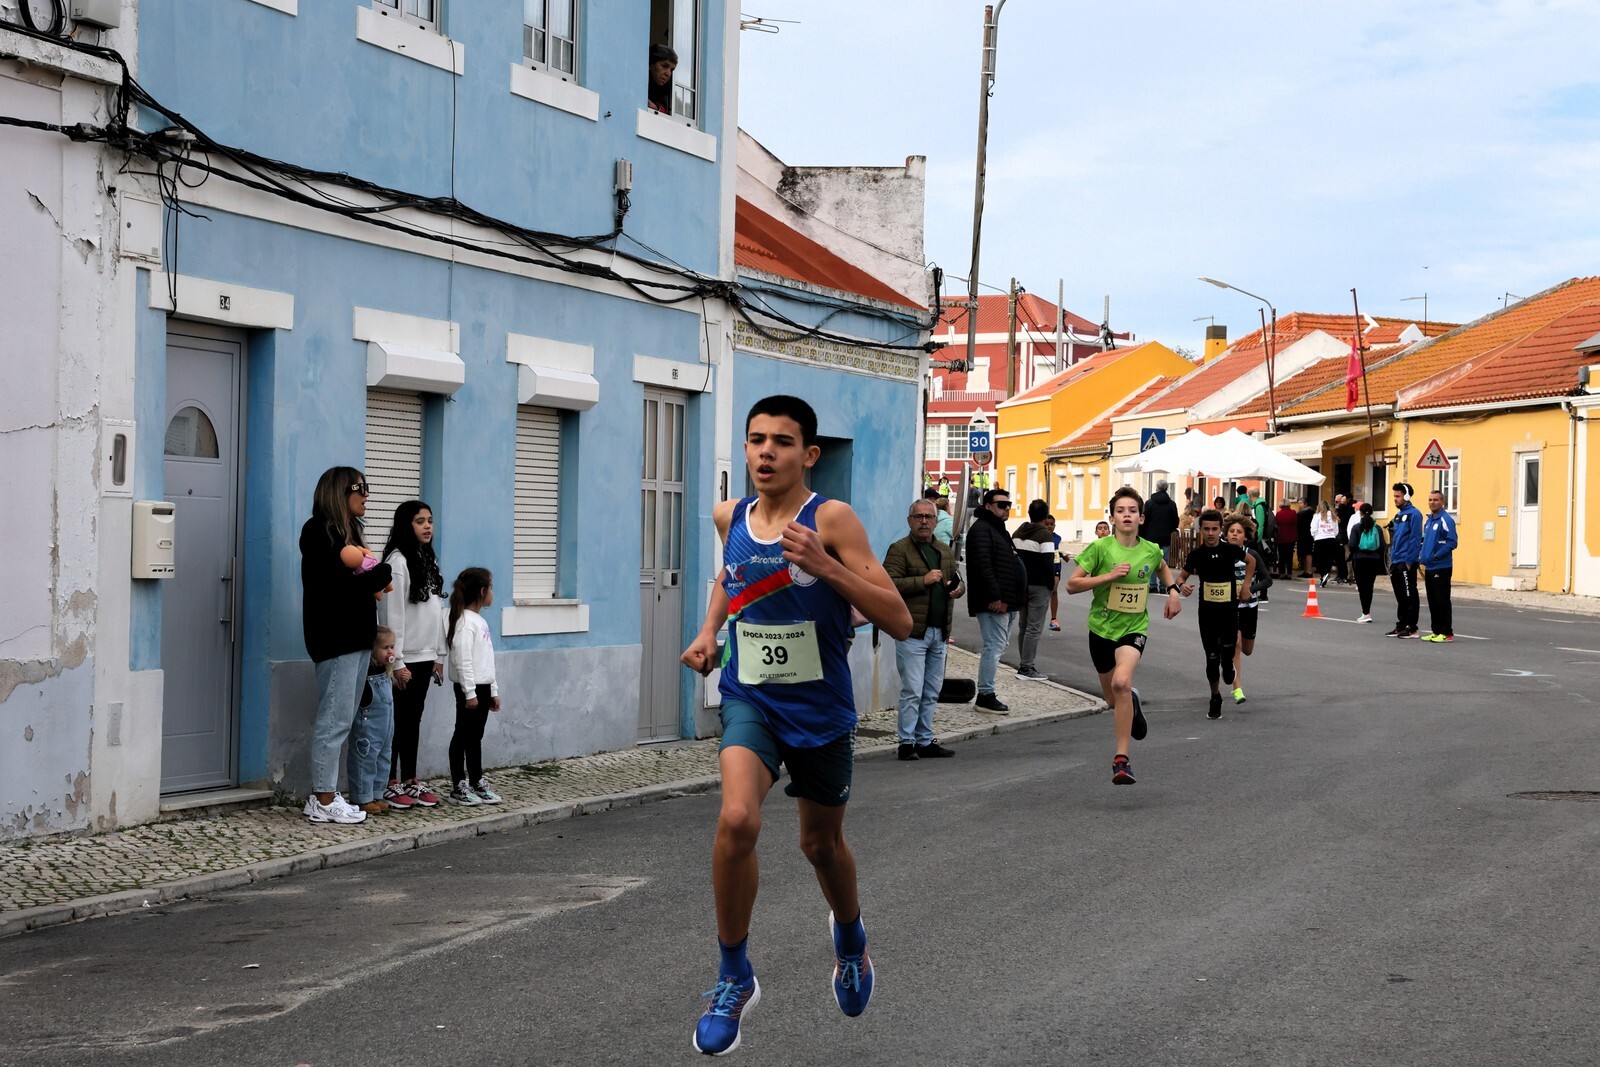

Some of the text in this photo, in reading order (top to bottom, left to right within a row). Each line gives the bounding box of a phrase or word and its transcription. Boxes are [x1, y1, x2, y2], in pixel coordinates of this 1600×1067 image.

[220, 296, 230, 310] 34
[971, 436, 988, 448] 30
[1120, 592, 1139, 603] 731
[1210, 588, 1225, 596] 558
[764, 630, 805, 640] 2023/2024
[761, 645, 789, 665] 39
